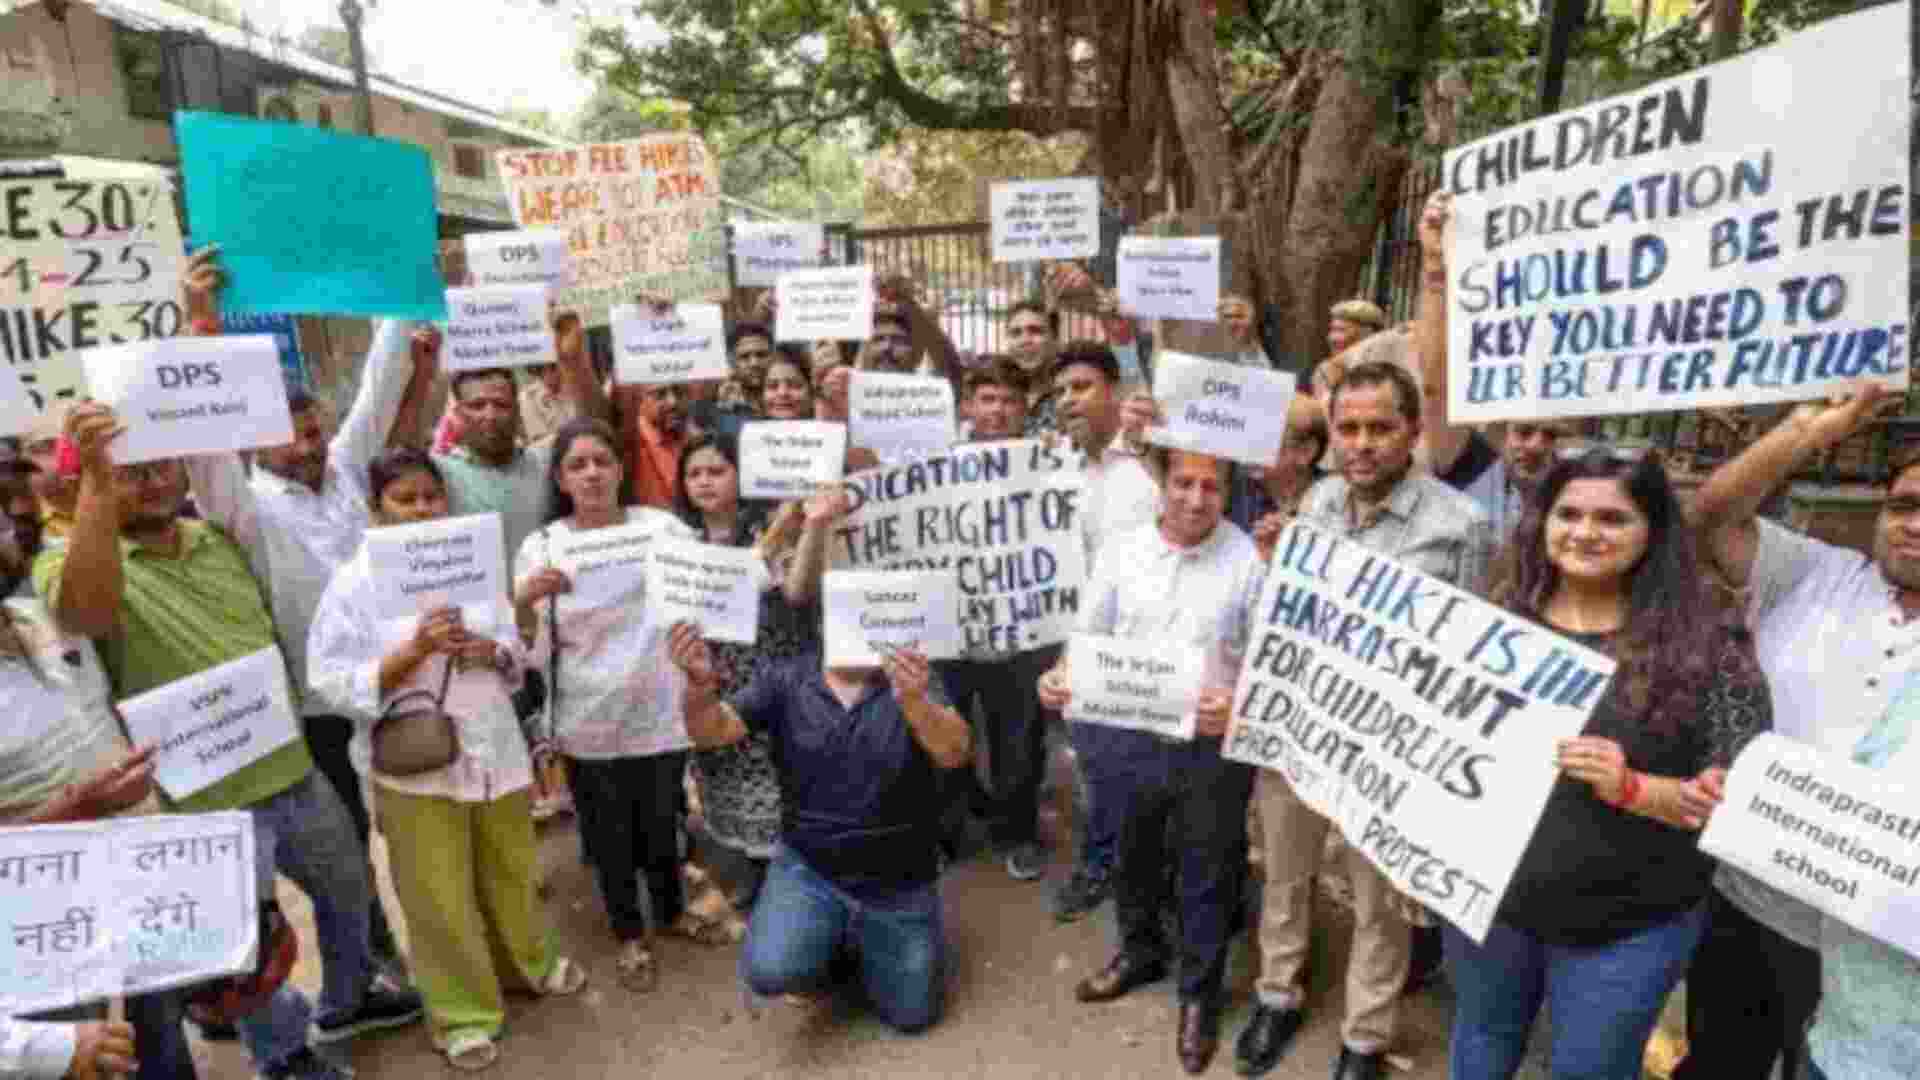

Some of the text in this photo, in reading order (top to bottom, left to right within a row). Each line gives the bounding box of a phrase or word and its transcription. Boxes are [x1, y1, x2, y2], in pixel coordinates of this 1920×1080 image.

[1450, 75, 1709, 196] CHILDREN
[0, 185, 39, 240] E
[1483, 148, 1773, 252] EDUCATION
[500, 243, 541, 263] DPS
[1459, 185, 1903, 313] SHOULD BE THE
[1468, 274, 1848, 362] KEY YOU NEED TO
[156, 362, 222, 388] DPS
[1465, 323, 1905, 403] UR BETTER FUTURE
[834, 488, 1078, 564] THE RIGHT OF
[957, 546, 1057, 596] CHILD
[1268, 582, 1528, 741] HARRASMENT
[1464, 618, 1532, 677] IS
[1238, 682, 1410, 813] EDUCATION
[1360, 817, 1494, 918] PROTEST
[1772, 847, 1857, 900] school
[12, 905, 96, 957] नहीं
